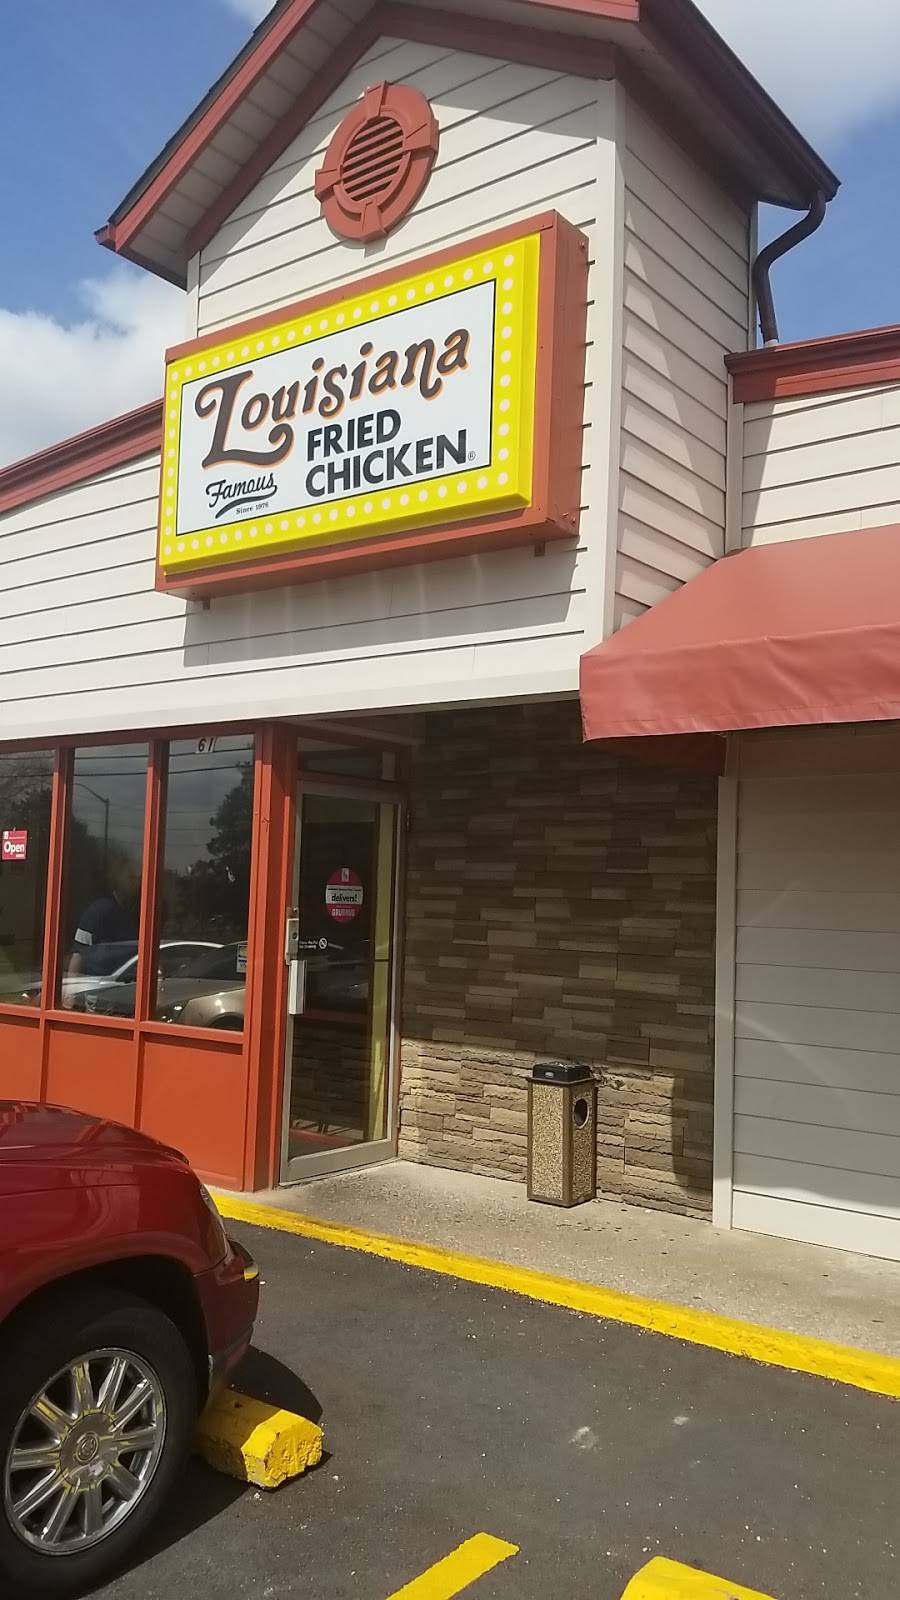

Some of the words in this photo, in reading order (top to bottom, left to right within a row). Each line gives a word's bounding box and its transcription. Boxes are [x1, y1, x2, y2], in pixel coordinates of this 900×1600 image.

[194, 328, 471, 469] Louisiana
[307, 408, 401, 462] FRIED
[305, 429, 467, 498] CHICKEN
[205, 472, 277, 508] Famous
[236, 505, 253, 515] Since
[4, 841, 25, 856] Open
